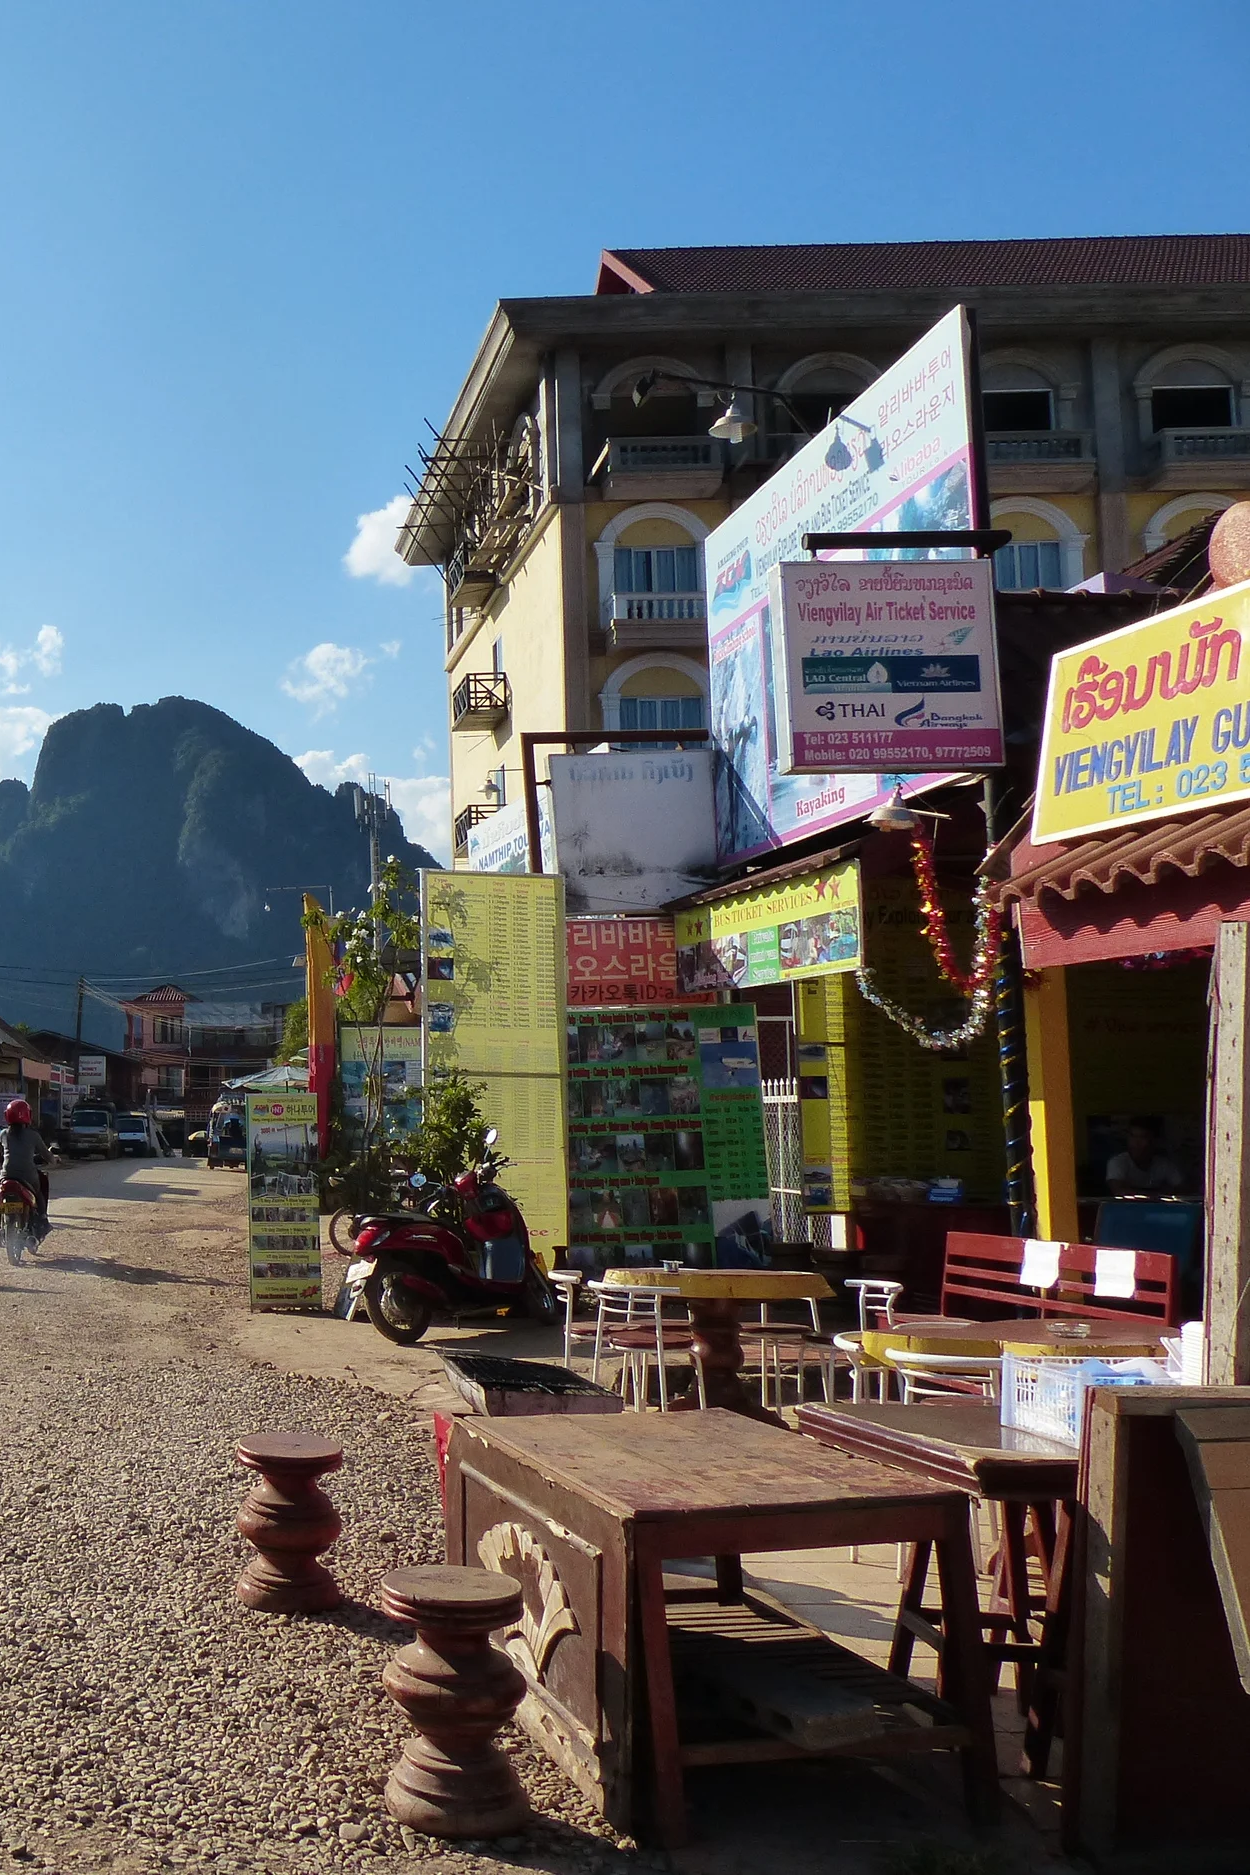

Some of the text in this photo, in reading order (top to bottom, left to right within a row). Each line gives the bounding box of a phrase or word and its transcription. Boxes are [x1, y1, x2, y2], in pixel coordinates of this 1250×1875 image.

[878, 345, 952, 428] 알리바바투어
[797, 601, 976, 627] Viengvilay Air Ticket Service
[809, 646, 924, 657] Lao Airlines
[805, 673, 866, 683] LAO Central
[939, 679, 976, 687] Airlines
[838, 703, 885, 718] THAI
[930, 712, 983, 722] Bangkok
[920, 720, 968, 730] Airways
[804, 732, 893, 745] Tel: 023 511177
[804, 746, 992, 761] Mobile: 020 99552170, 97772509
[1054, 715, 1199, 797] VIENGVILAY
[1176, 760, 1228, 798] 023
[796, 785, 846, 818] Kayaking
[478, 843, 513, 871] NAMTHIP
[514, 833, 529, 857] TOU
[714, 892, 813, 929] BUS TICKET SERVICES
[567, 922, 675, 950] 리바바투
[286, 1103, 316, 1116] 하나투어
